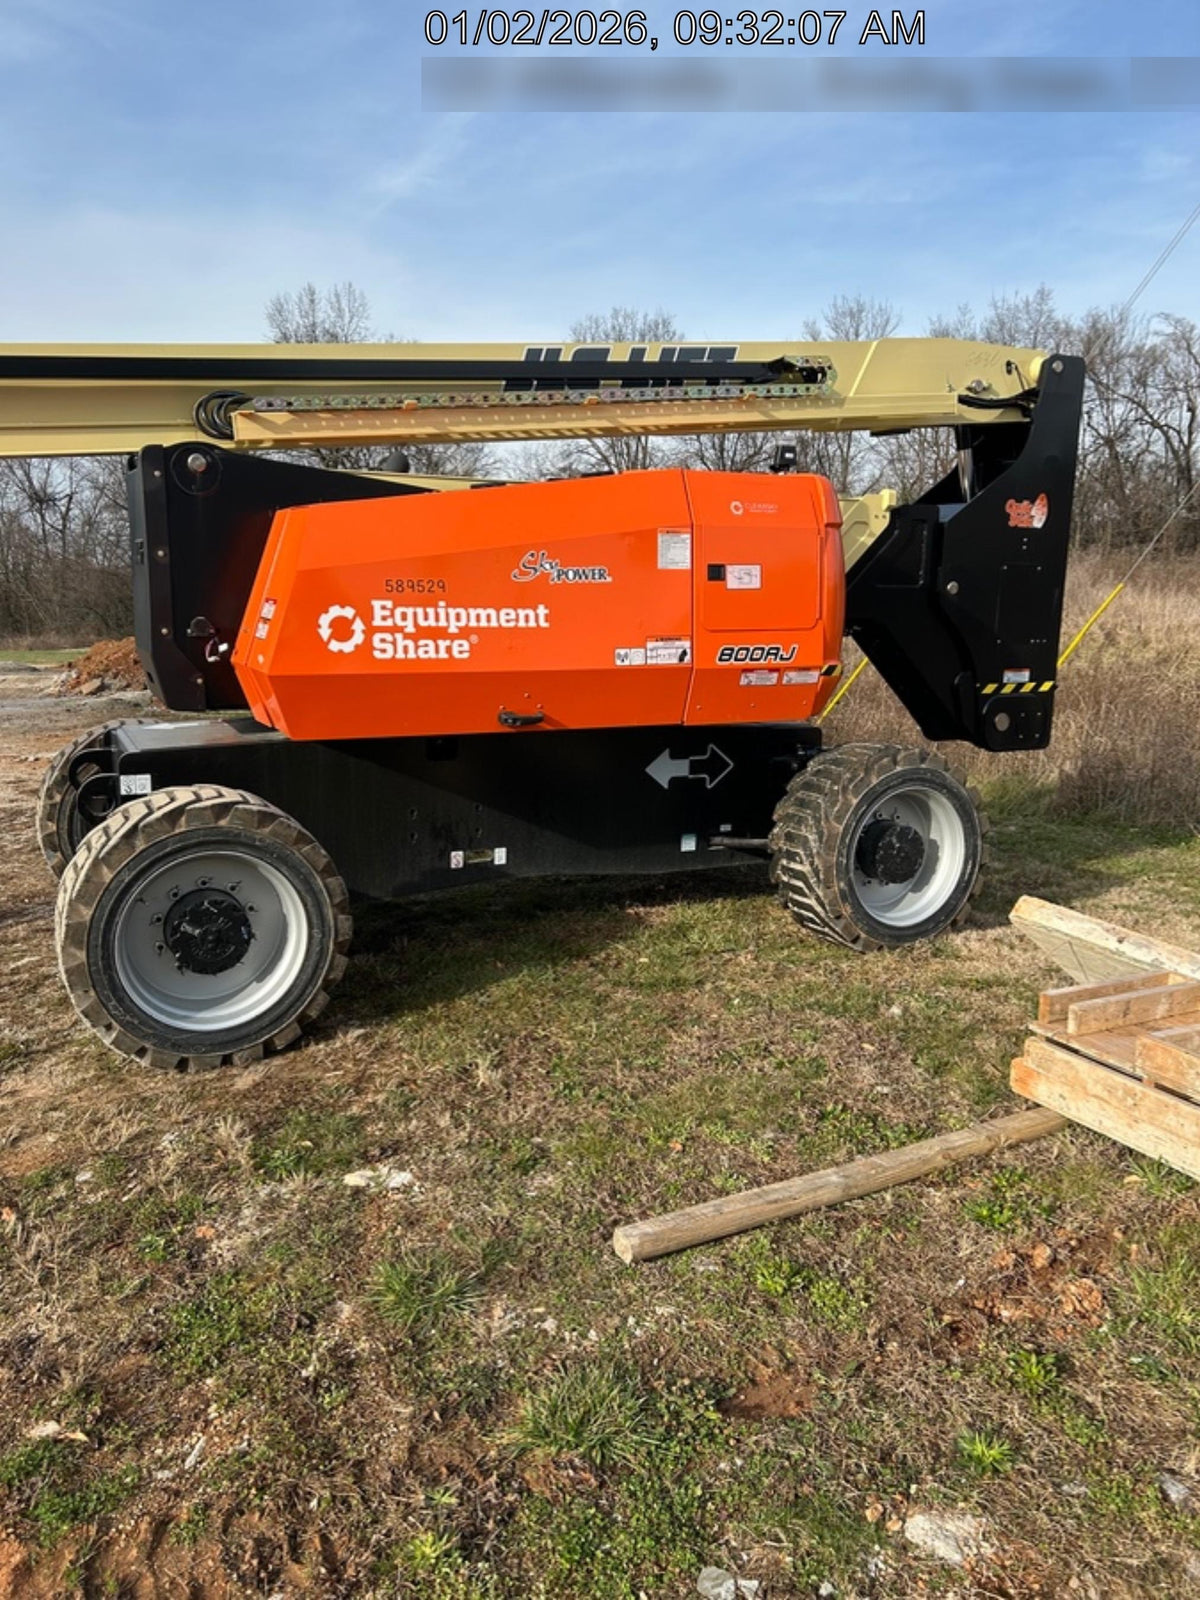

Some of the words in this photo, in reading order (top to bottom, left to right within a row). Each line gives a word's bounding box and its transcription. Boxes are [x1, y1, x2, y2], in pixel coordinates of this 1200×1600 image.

[511, 550, 559, 583] Sky
[385, 579, 447, 593] 589529
[371, 600, 550, 633] Equipment
[717, 645, 798, 665] 800AJ
